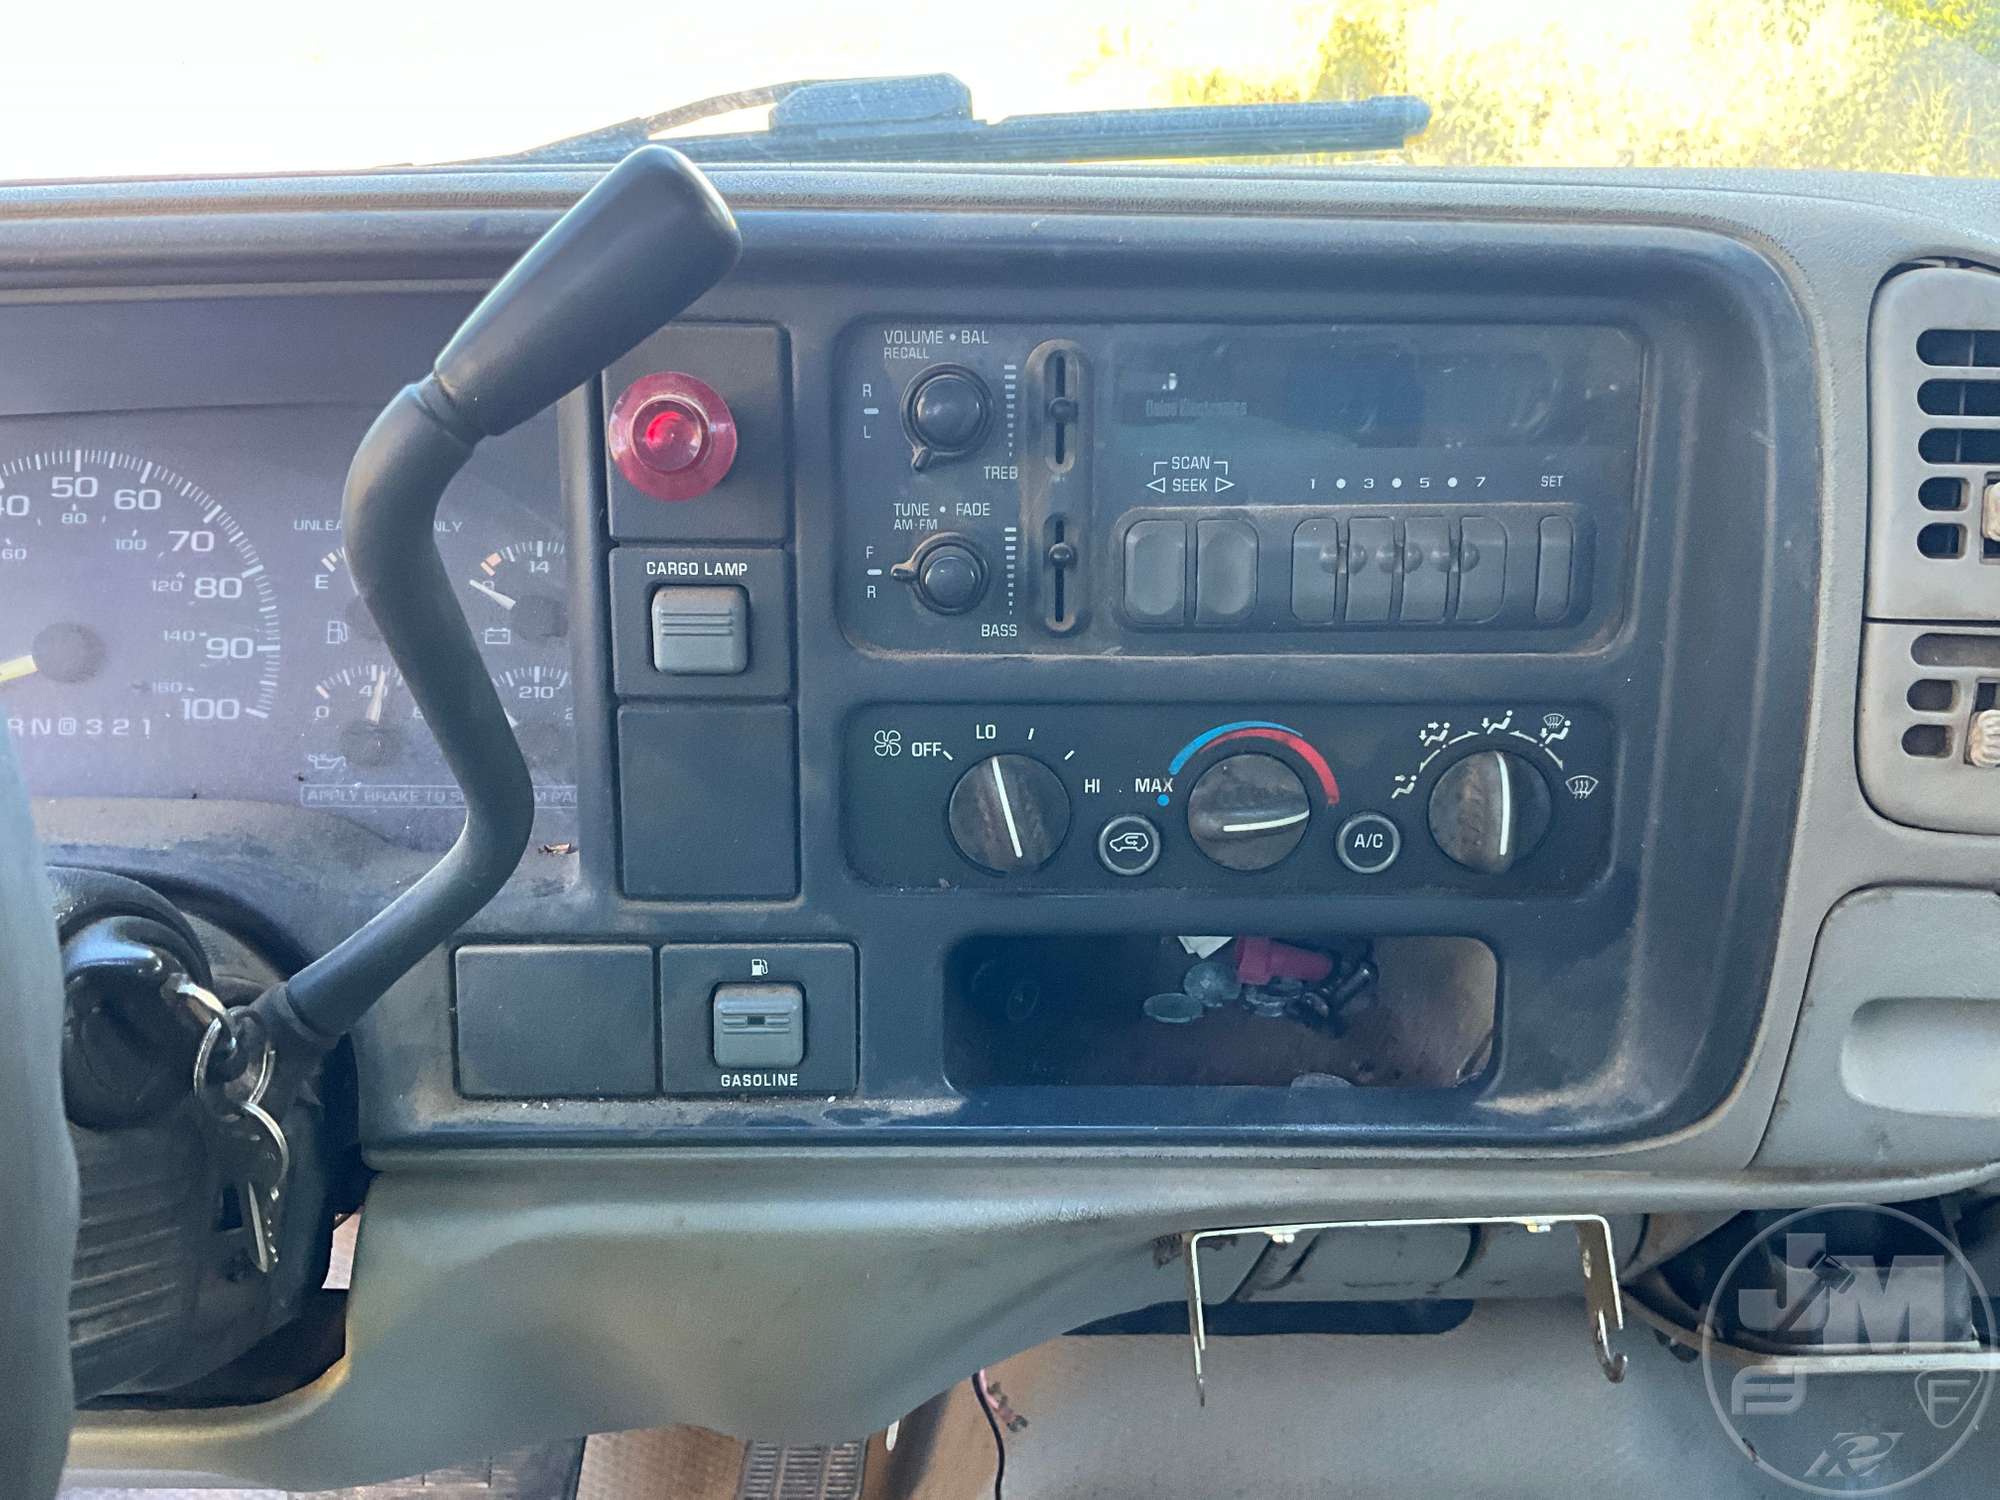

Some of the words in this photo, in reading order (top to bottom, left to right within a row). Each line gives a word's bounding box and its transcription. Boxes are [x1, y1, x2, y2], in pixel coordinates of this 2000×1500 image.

[884, 330, 944, 345] VOLUME
[961, 330, 990, 345] BAL
[884, 347, 930, 360] RECALL
[862, 383, 873, 398] R
[863, 425, 872, 439] L
[1171, 456, 1210, 470] SCAN
[984, 466, 1018, 480] TREB
[51, 476, 98, 498] 50
[1172, 478, 1208, 492] SEEK
[1310, 478, 1316, 490] 1
[1363, 478, 1375, 489] 3
[1419, 477, 1430, 488] 5
[1475, 476, 1486, 488] 7
[1540, 475, 1564, 488] SET
[113, 489, 161, 510] 60
[893, 503, 930, 517] TUNE
[956, 503, 991, 517] FADE
[61, 512, 88, 524] 80
[293, 520, 343, 531] UNLEA
[433, 521, 463, 532] NLY
[115, 538, 147, 551] 100
[168, 530, 215, 552] 70
[2, 549, 27, 560] 60
[866, 546, 874, 559] F
[529, 561, 549, 573] 14
[646, 561, 699, 575] CARGO
[704, 562, 748, 576] LAMP
[152, 579, 183, 592] 120
[194, 577, 242, 599] 80
[315, 574, 329, 589] E
[867, 586, 876, 598] R
[163, 630, 196, 641] 140
[981, 624, 1018, 637] BASS
[206, 637, 254, 659] 90
[519, 686, 554, 699] 210
[180, 698, 240, 720] 100
[315, 706, 329, 718] 0
[976, 725, 997, 739] LO
[912, 742, 942, 757] OFF
[1084, 779, 1101, 793] HI
[1135, 778, 1173, 792] MAX
[1354, 833, 1383, 849] A/C
[721, 1074, 798, 1087] GASOLINE
